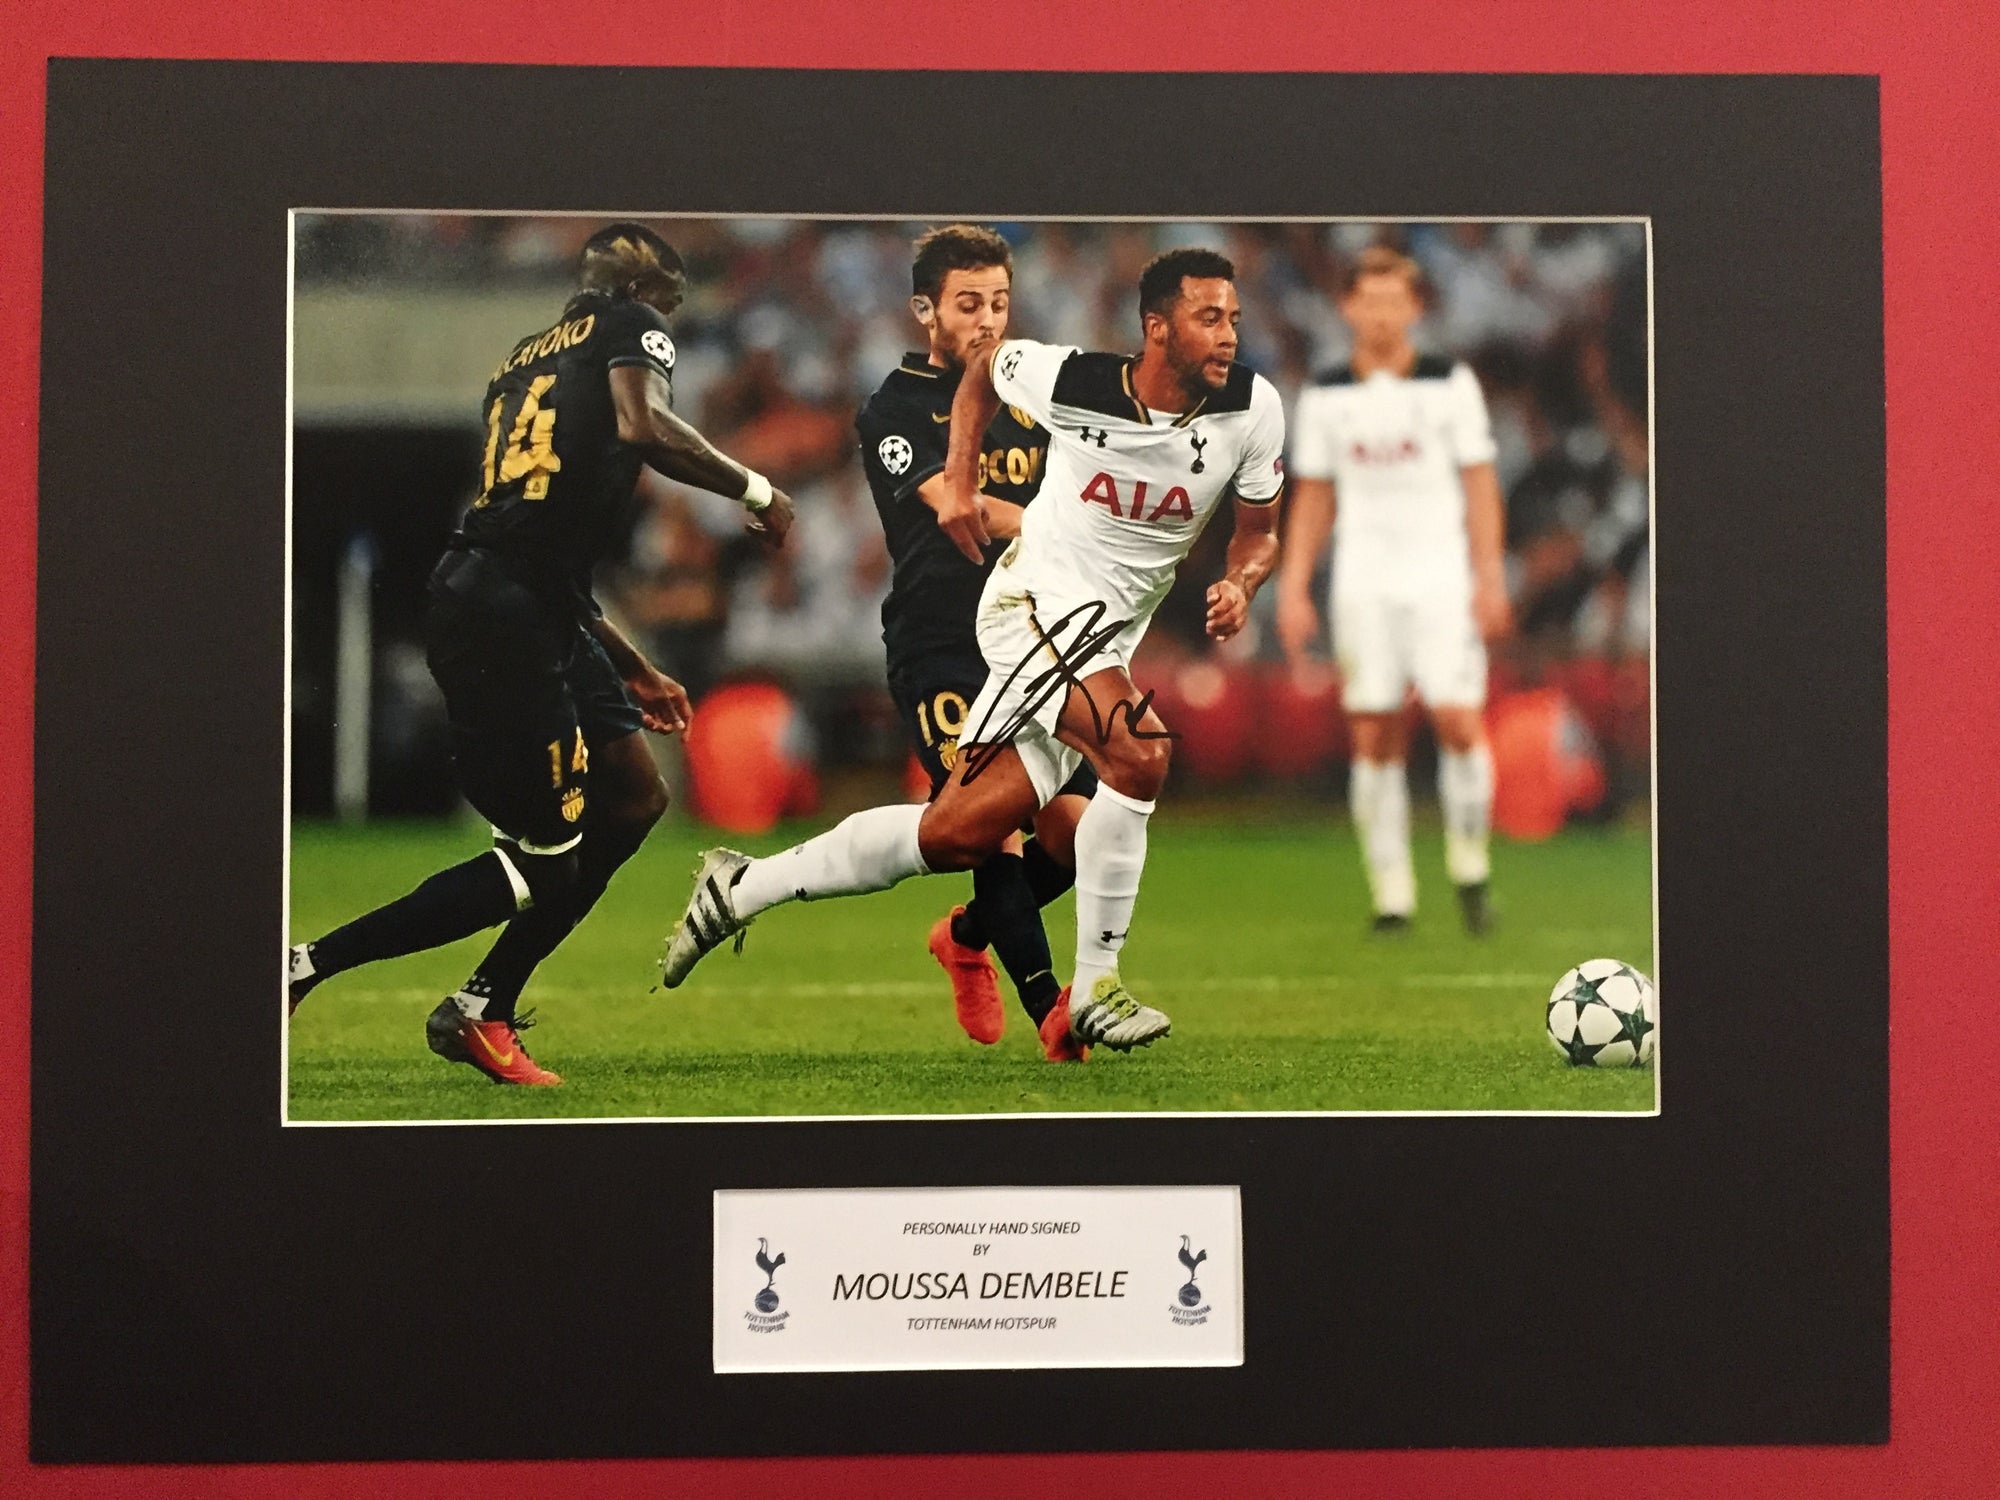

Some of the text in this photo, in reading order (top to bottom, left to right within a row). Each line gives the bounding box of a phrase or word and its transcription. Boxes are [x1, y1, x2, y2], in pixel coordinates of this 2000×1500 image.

[474, 374, 561, 508] 14
[1080, 471, 1194, 522] AIA
[917, 691, 969, 747] 10
[902, 1221, 1081, 1236] PERSONALLY HAND SIGNED
[972, 1243, 991, 1257] BY
[832, 1270, 1129, 1301] MOUSSA DEMBELE
[907, 1316, 1058, 1331] TOTTENHAM HOTSPUR
